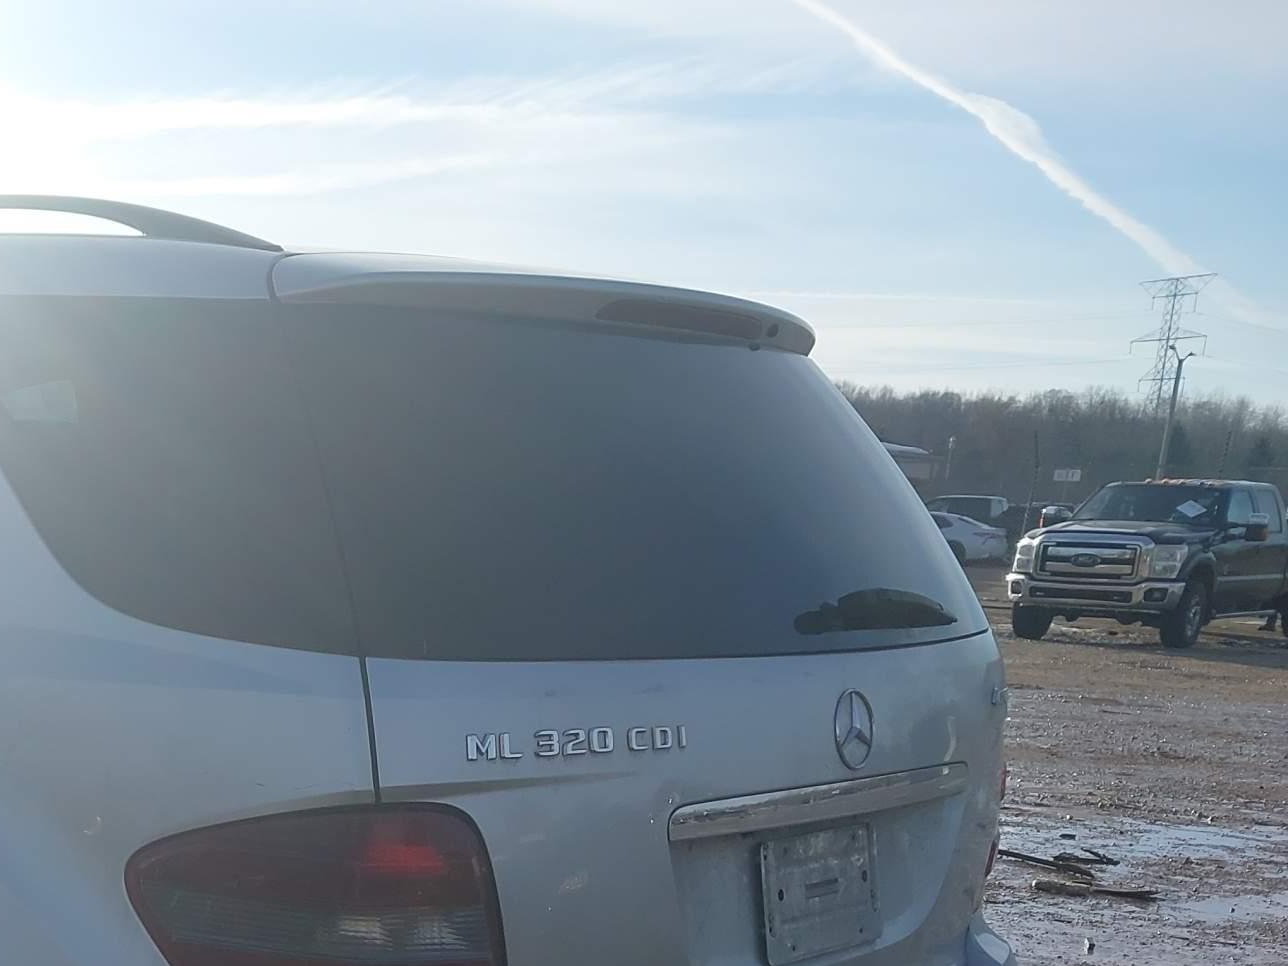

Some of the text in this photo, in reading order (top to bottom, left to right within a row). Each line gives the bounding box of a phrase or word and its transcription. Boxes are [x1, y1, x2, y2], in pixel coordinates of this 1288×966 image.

[466, 726, 688, 760] ML 320 CDI
